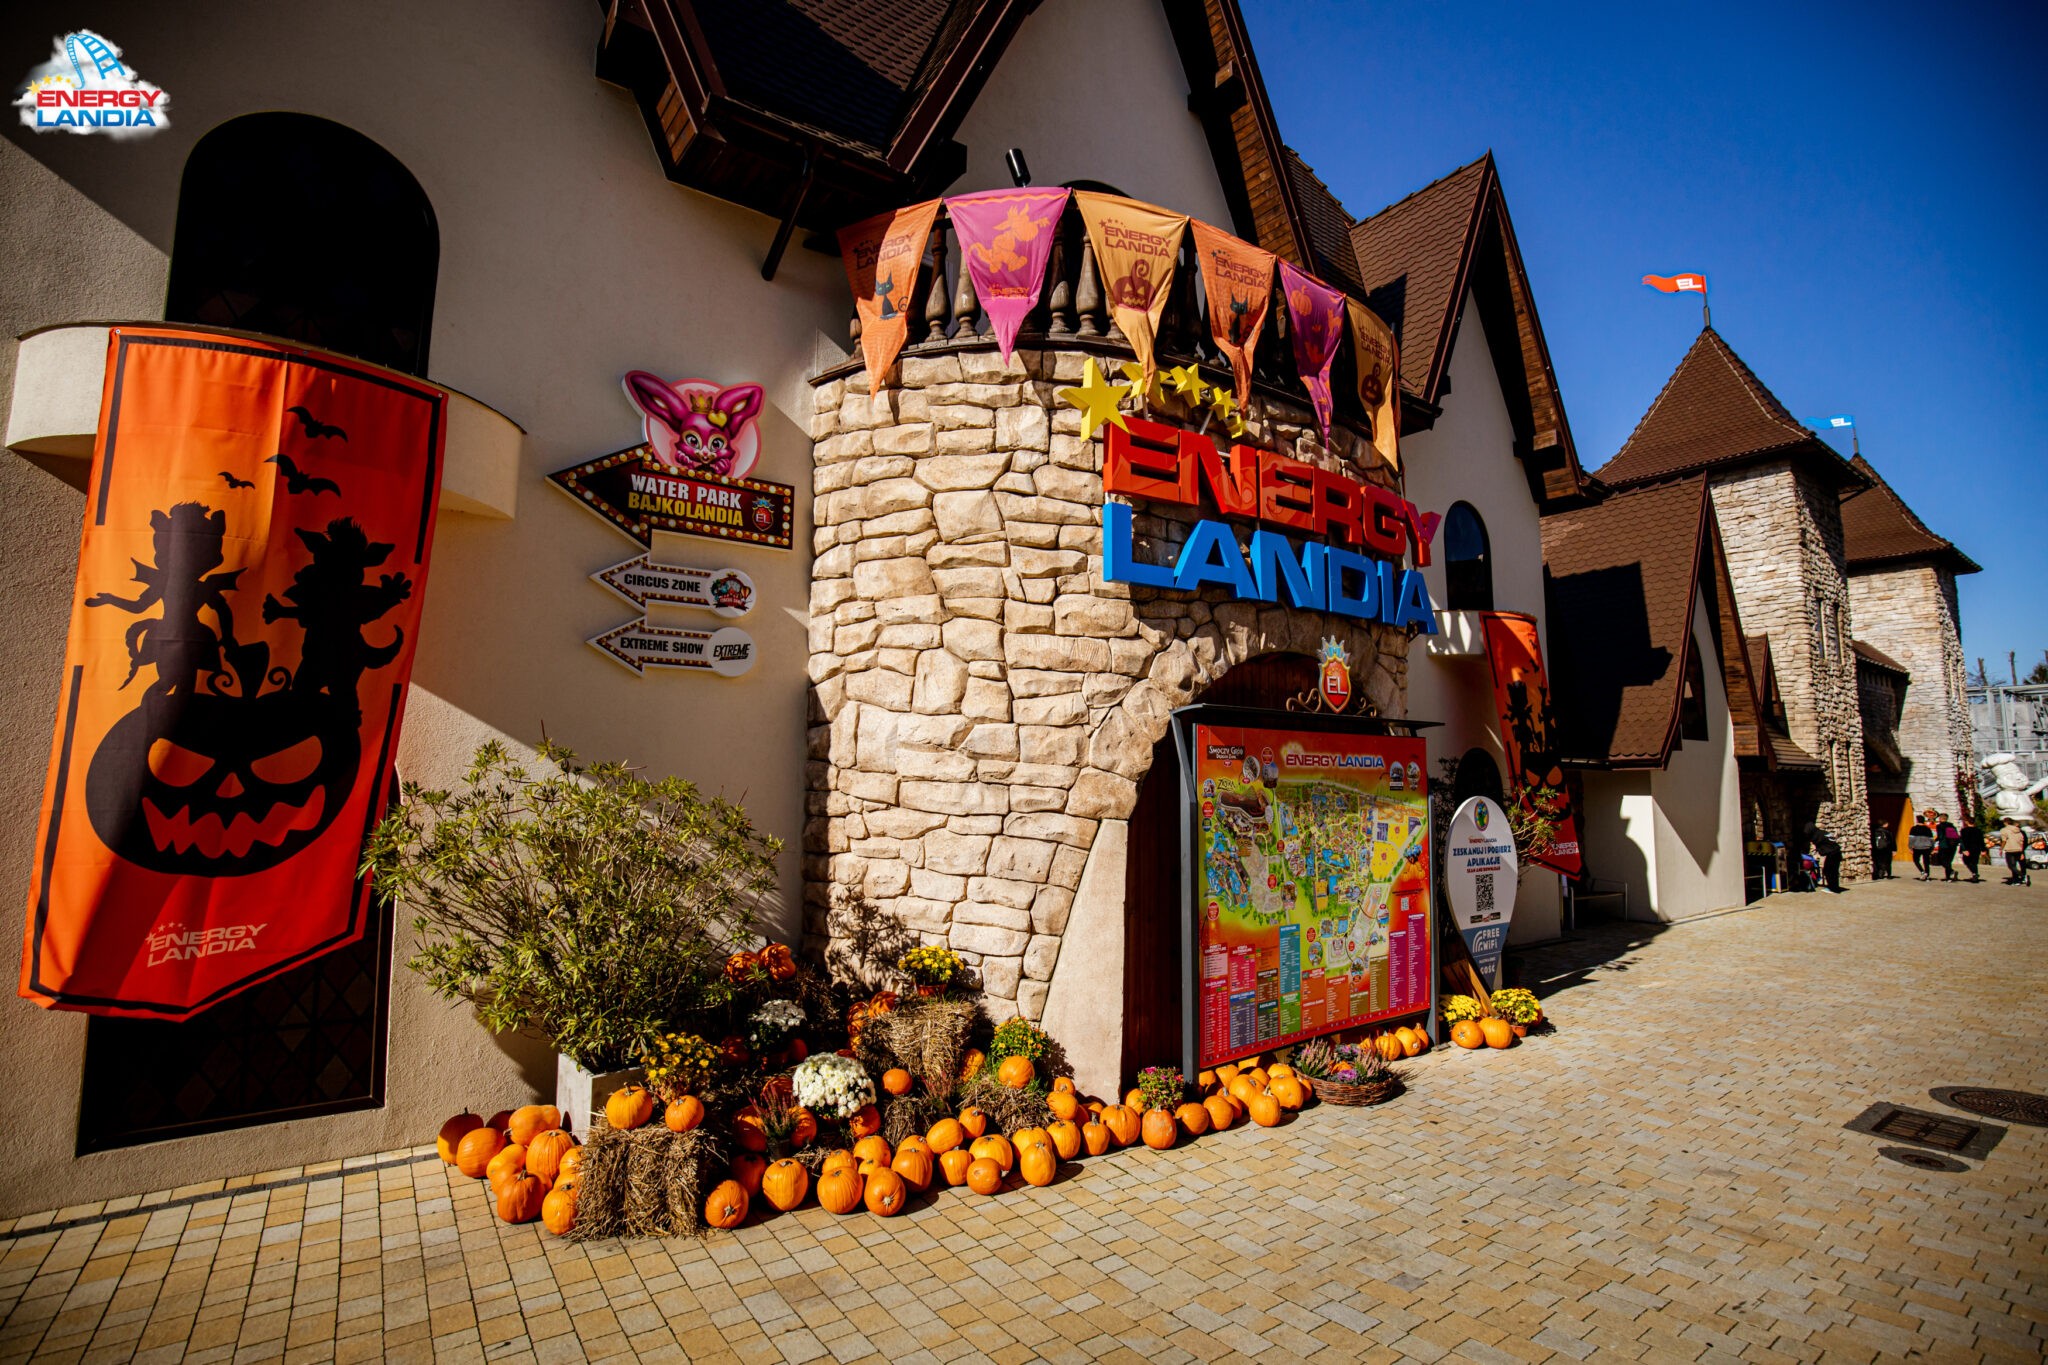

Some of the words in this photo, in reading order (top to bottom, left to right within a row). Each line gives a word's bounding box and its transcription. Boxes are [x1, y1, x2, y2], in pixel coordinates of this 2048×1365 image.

[858, 232, 917, 258] ENERGY
[1105, 225, 1173, 248] ENERGY
[1105, 236, 1171, 259] LANDIA
[856, 246, 913, 270] LANDIA
[1216, 256, 1269, 279] ENERGY
[1216, 267, 1267, 290] LANDIA
[1676, 278, 1702, 290] EL
[631, 474, 689, 500] WATER
[697, 486, 742, 509] PARK
[1103, 415, 1441, 567] ENERGY
[628, 491, 744, 526] BAJKOLANDIA
[755, 513, 771, 524] EL
[1103, 502, 1438, 635] LANDIA
[624, 573, 669, 589] CIRCUS
[671, 579, 701, 593] ZONE
[620, 637, 669, 652] EXTREME
[672, 641, 704, 655] SHOW
[713, 644, 751, 658] EXTREME
[1327, 676, 1347, 694] EL
[1286, 753, 1384, 768] ENERGYLANDIA
[1453, 847, 1484, 856] ZESKANUJ
[1488, 845, 1511, 854] POBIERZ
[150, 923, 268, 952] ENERGY
[1482, 927, 1500, 939] FREE
[147, 937, 256, 968] LANDIA
